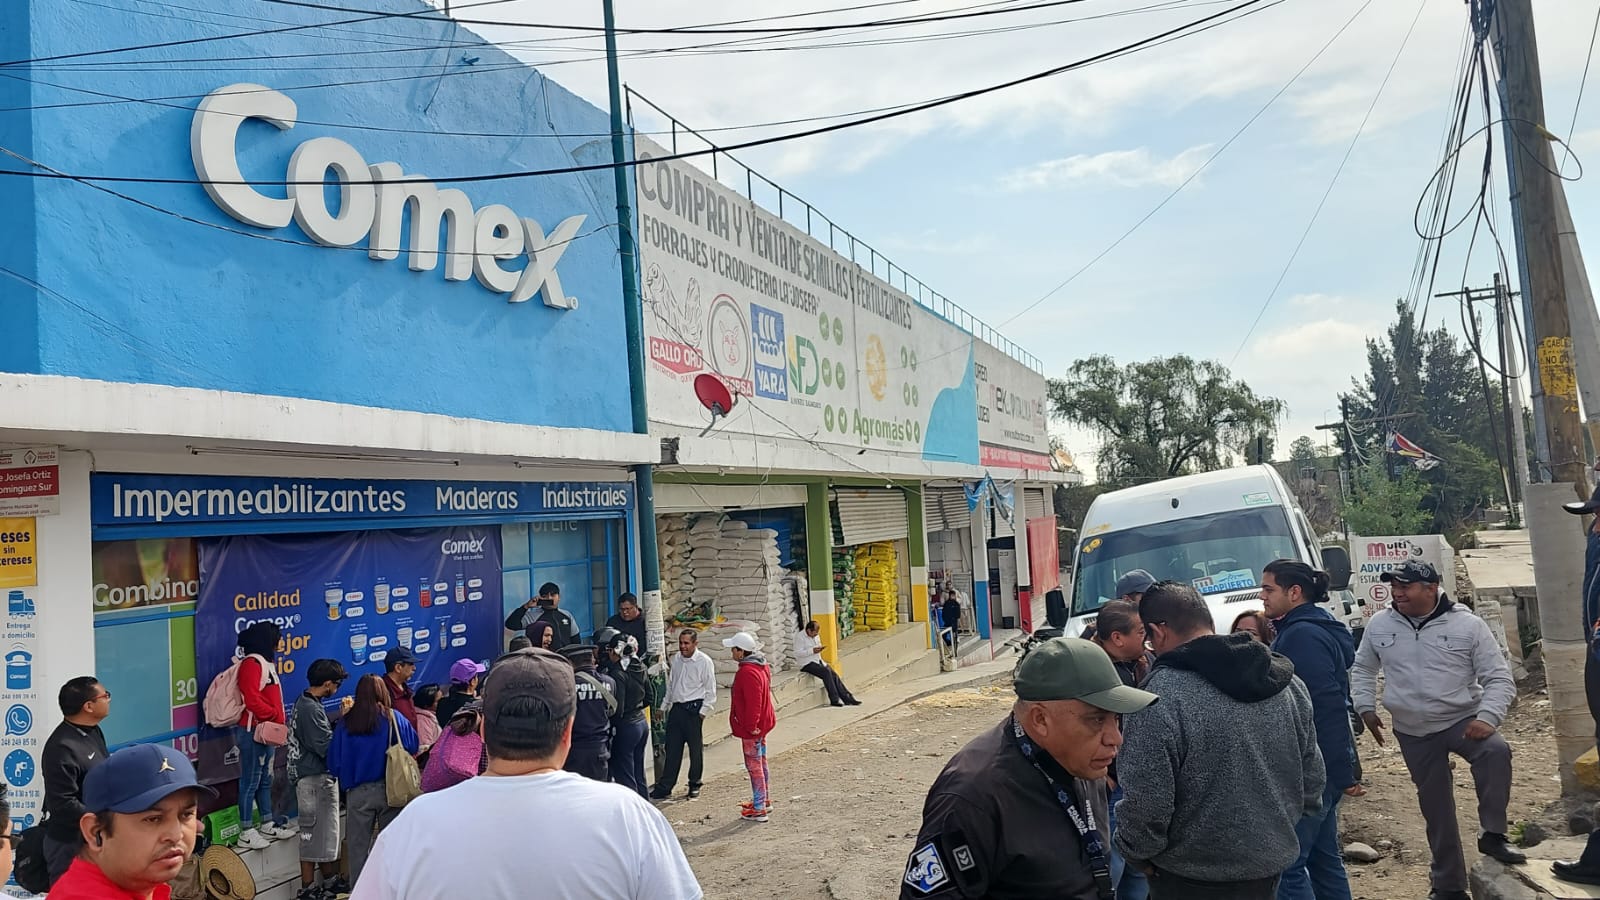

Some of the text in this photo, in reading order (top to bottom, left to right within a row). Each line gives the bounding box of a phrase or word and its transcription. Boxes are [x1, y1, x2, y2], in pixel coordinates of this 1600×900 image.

[638, 151, 730, 241] COMPRA
[733, 203, 742, 248] Y
[745, 210, 788, 271] VENTA
[789, 235, 802, 277] DE
[803, 244, 849, 300] SEMILLAS
[856, 273, 912, 330] FERTILIZANTES
[643, 213, 708, 269] FORRAJES
[710, 246, 717, 273] Y
[718, 249, 779, 300] CROQUETERIA
[651, 340, 703, 369] GALLO ORO
[756, 368, 786, 396] YARA
[853, 408, 904, 444] Agromás
[5, 471, 31, 482] Josefa
[32, 470, 52, 480] Ortiz
[38, 482, 53, 491] Sur
[112, 483, 627, 522] Impermeabilizantes Maderas Industriales
[1, 531, 30, 543] eses
[441, 536, 487, 555] Comex
[3, 545, 16, 554] sin
[1360, 562, 1393, 573] ADVER
[1360, 575, 1381, 584] ESTAC
[234, 588, 301, 612] Calidad
[1374, 587, 1384, 599] E
[6, 622, 31, 630] Entrega
[276, 632, 312, 656] ejor
[176, 677, 198, 701] 30
[578, 690, 603, 700] VIA
